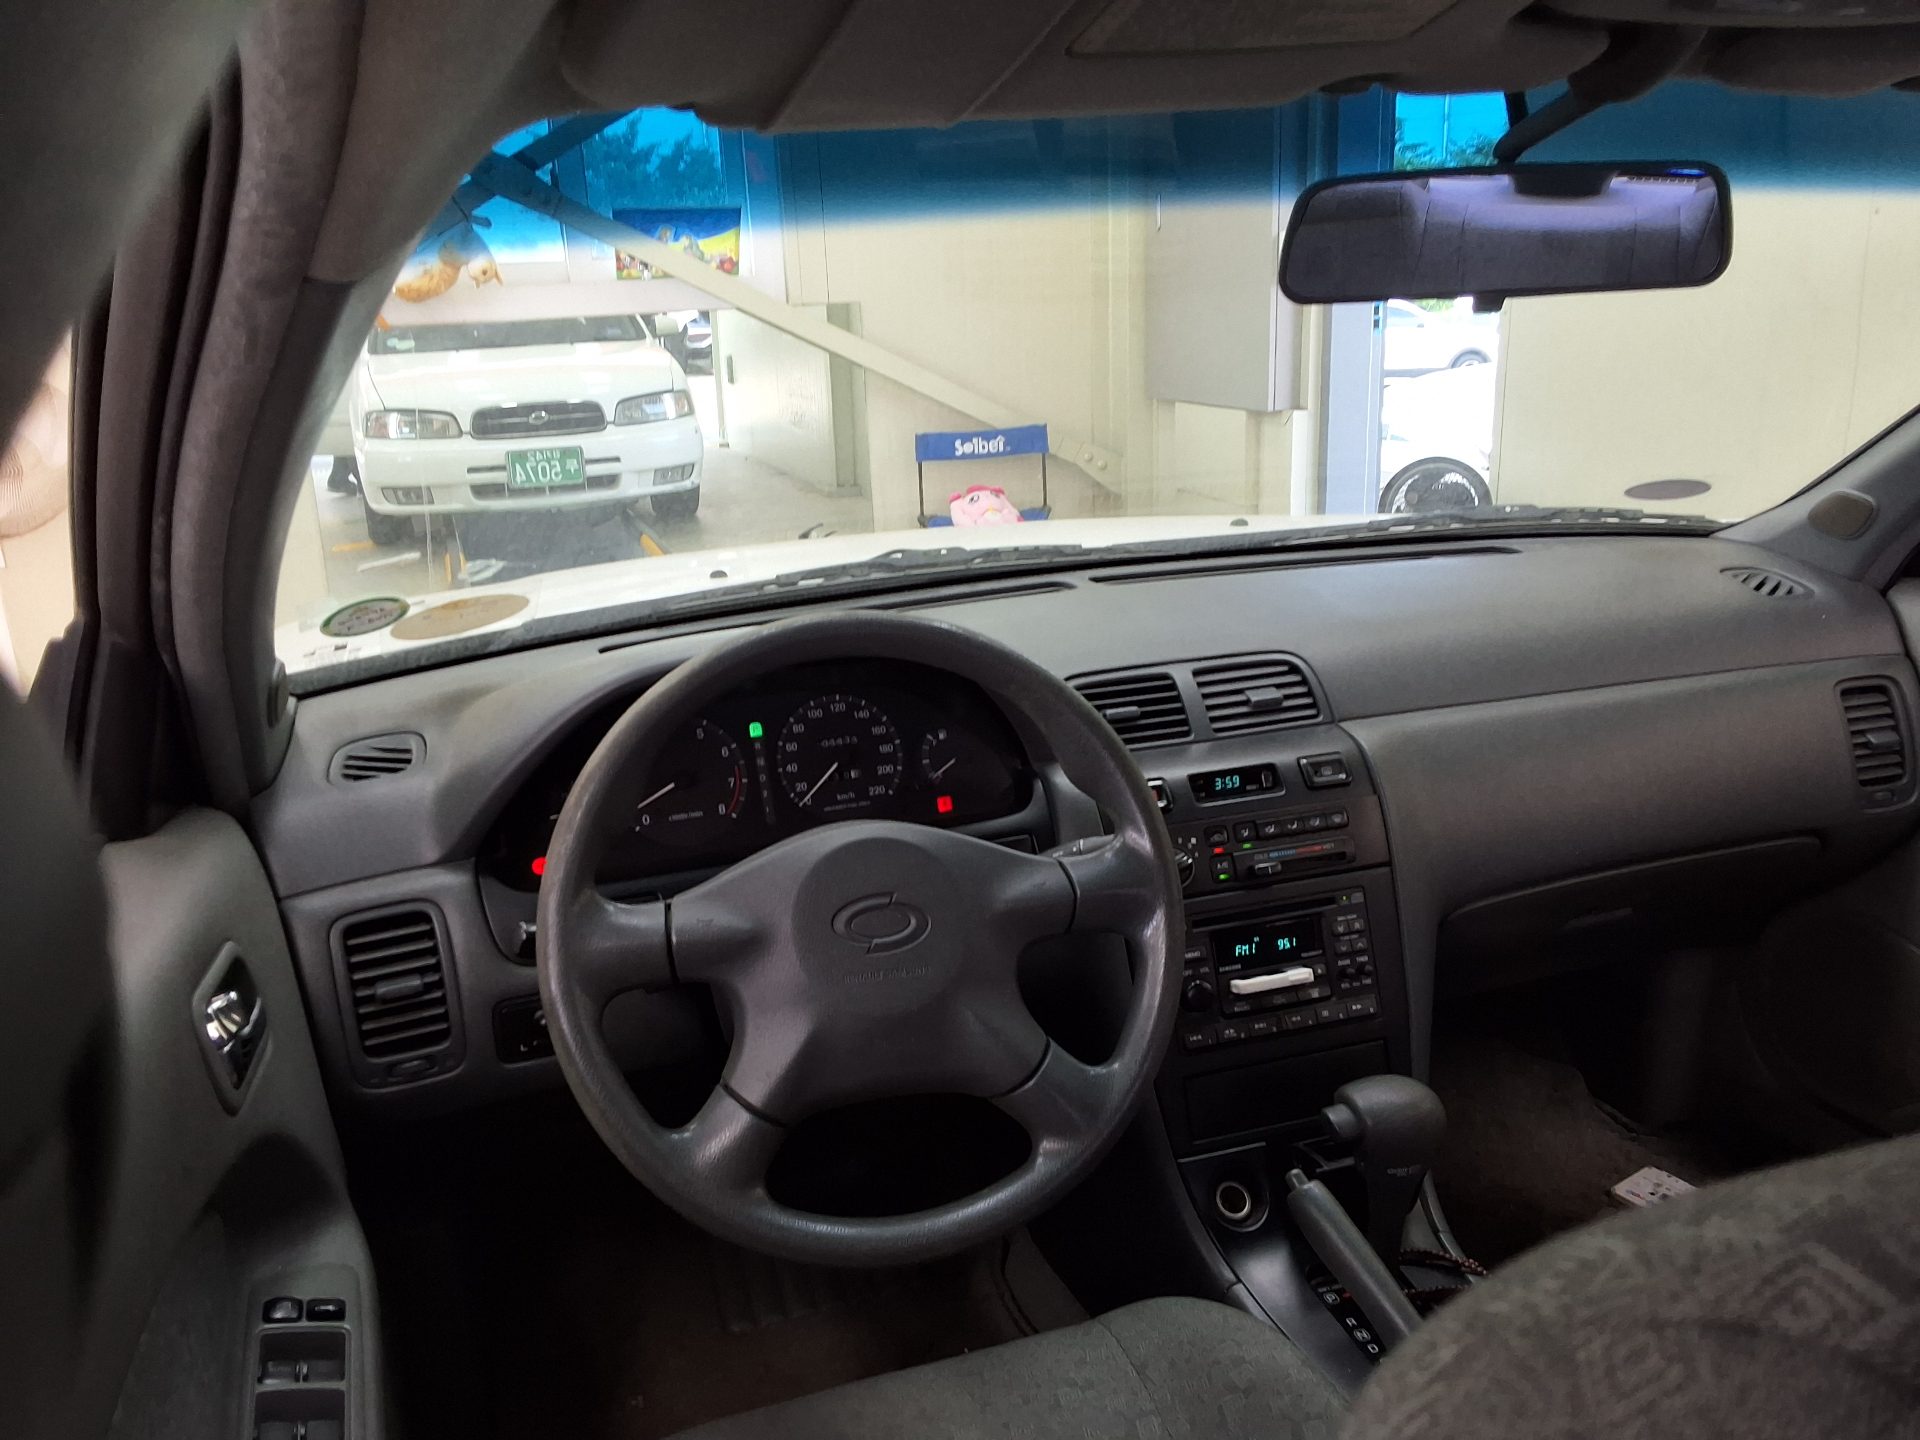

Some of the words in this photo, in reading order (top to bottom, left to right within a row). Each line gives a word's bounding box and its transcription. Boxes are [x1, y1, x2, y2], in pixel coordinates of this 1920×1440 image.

[830, 702, 846, 713] 120
[807, 708, 823, 719] 100
[854, 709, 870, 720] 140
[785, 741, 798, 753] 60
[785, 762, 798, 773] 40
[877, 764, 894, 776] 200
[795, 782, 808, 792] 20
[1214, 774, 1240, 791] 3:59
[868, 785, 886, 796] 220
